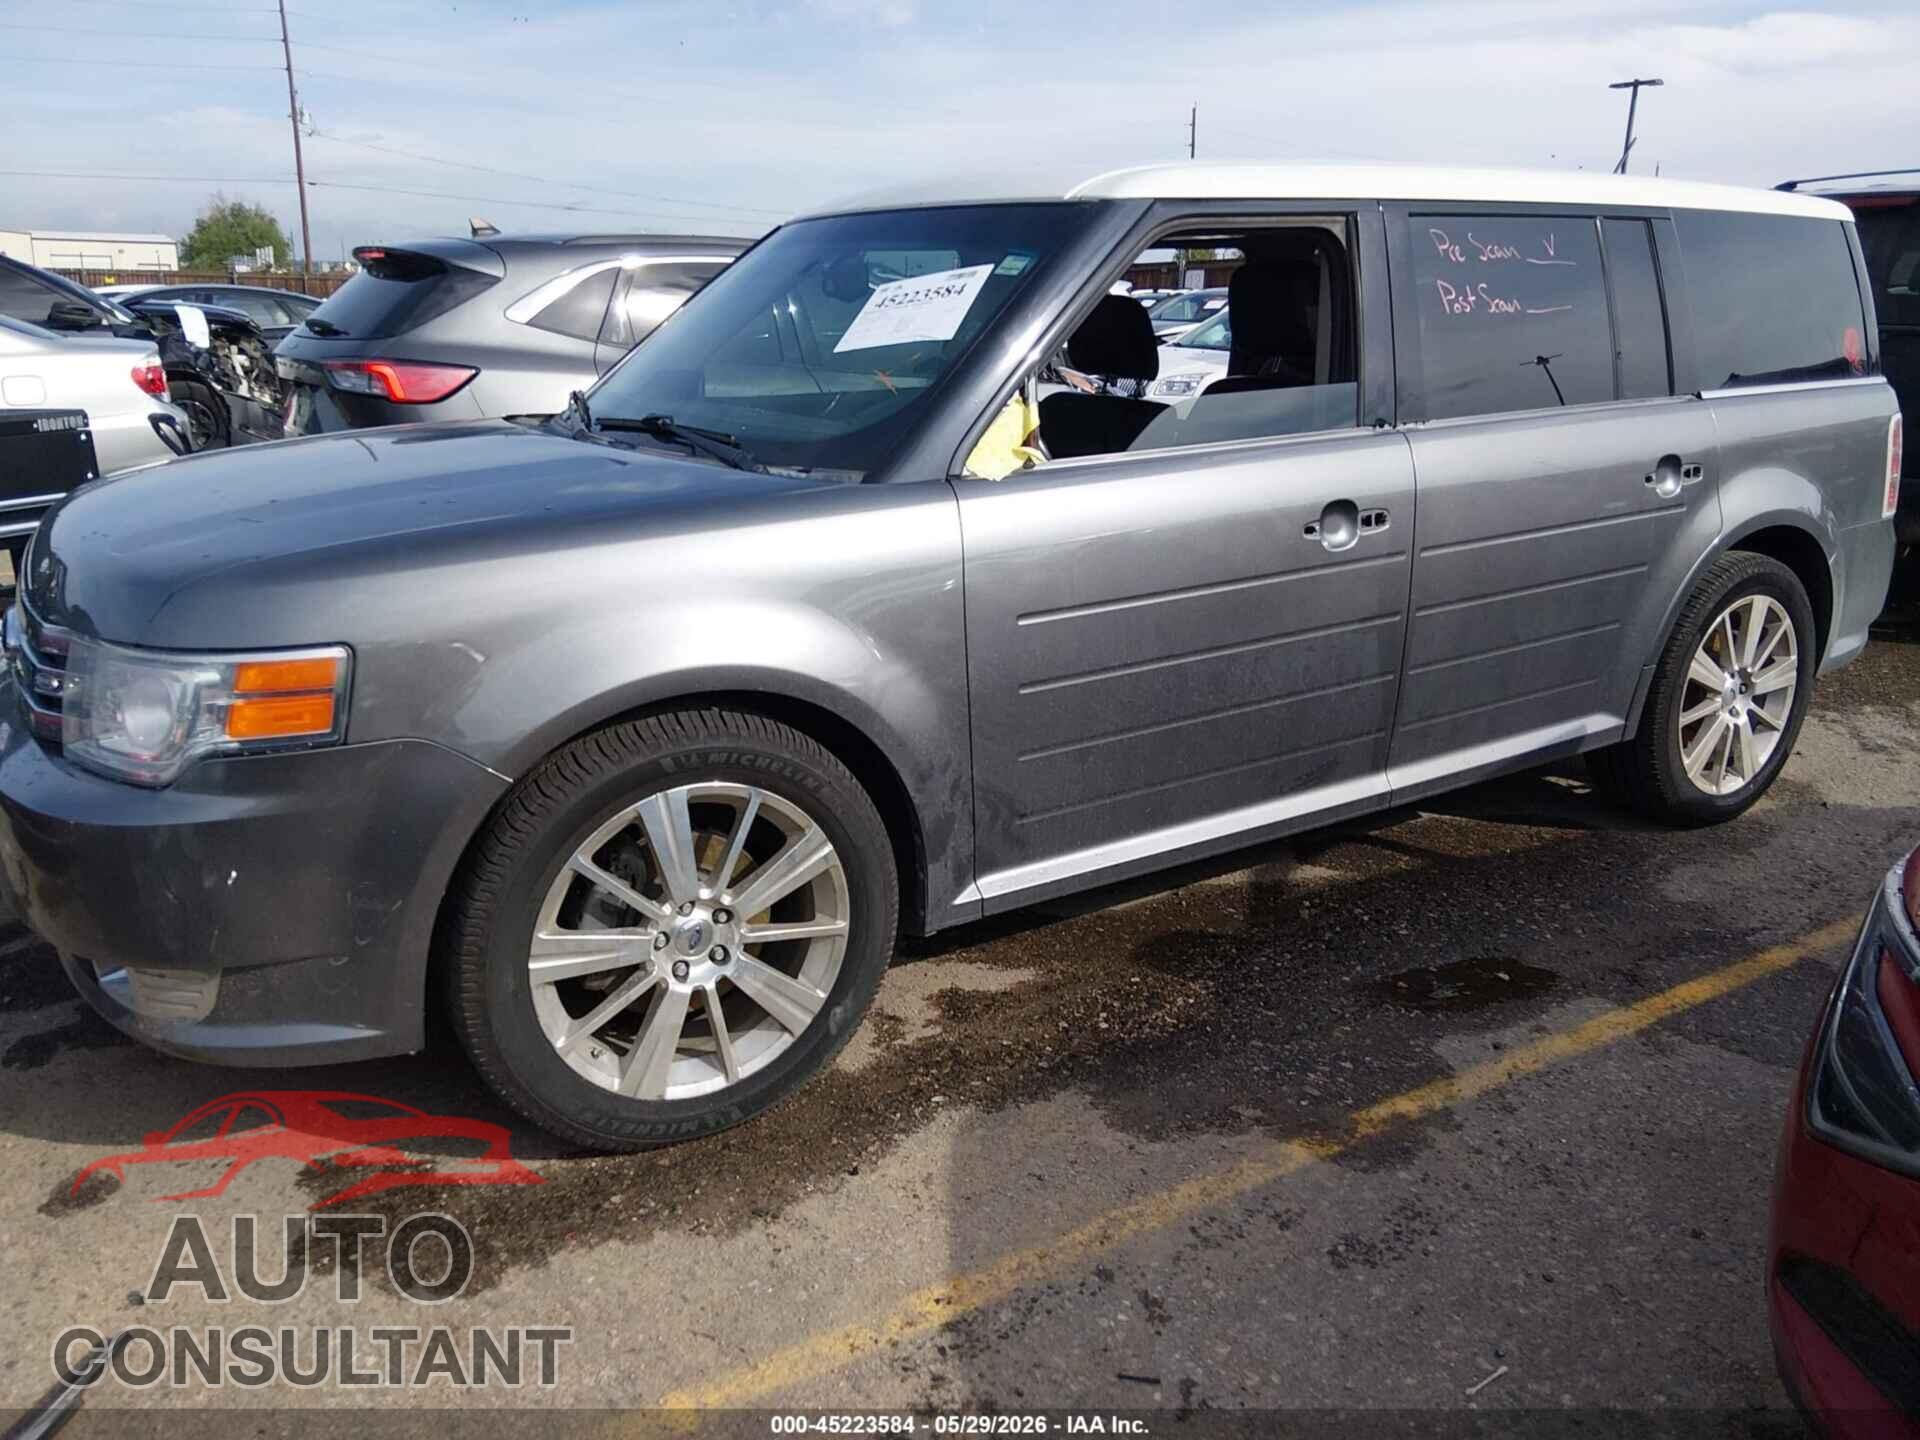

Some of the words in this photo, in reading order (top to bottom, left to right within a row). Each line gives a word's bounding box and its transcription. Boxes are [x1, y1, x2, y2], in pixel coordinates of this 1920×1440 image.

[1429, 228, 1466, 262] Pre
[1467, 232, 1521, 261] Scan
[874, 282, 967, 309] 45223584
[1436, 279, 1476, 314] Post
[1477, 283, 1521, 312] Scan
[707, 752, 820, 789] MICHELIN
